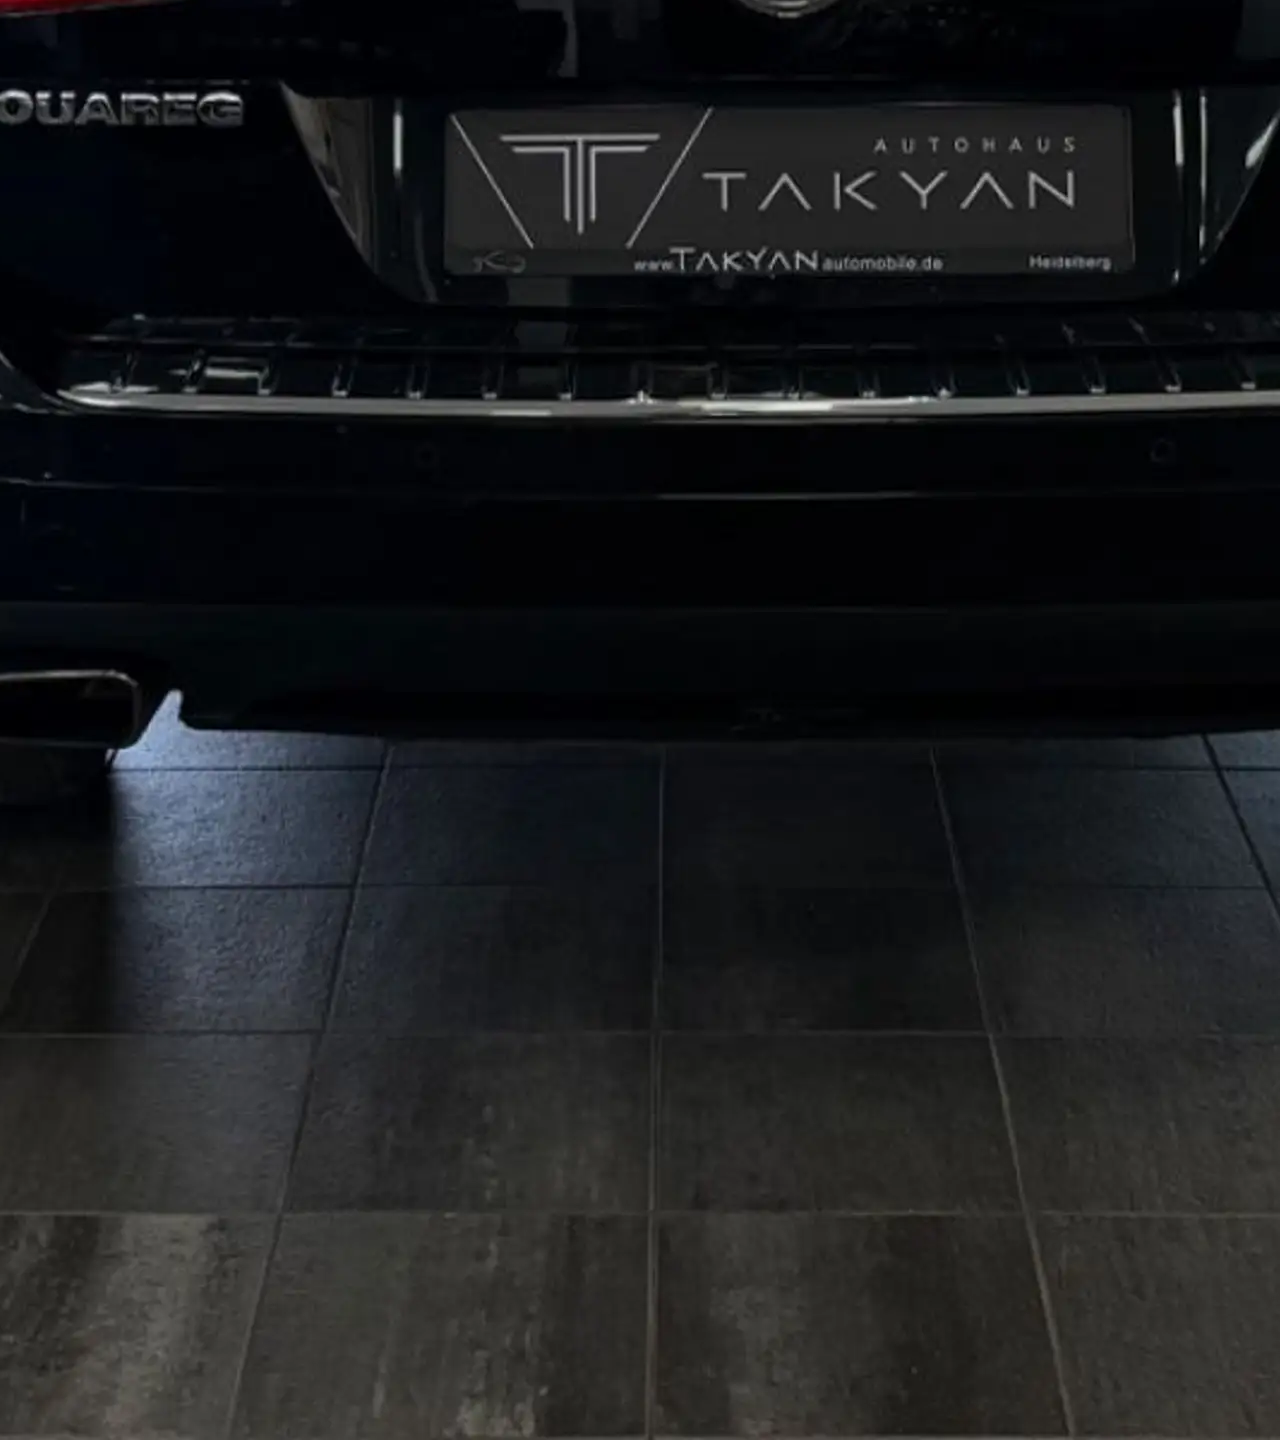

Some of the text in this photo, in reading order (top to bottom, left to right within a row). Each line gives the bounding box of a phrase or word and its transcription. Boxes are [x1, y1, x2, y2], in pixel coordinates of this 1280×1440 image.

[873, 136, 1076, 154] AUTOHAUS
[701, 170, 1076, 212] TAKYAN
[1029, 255, 1112, 272] Heidelberg
